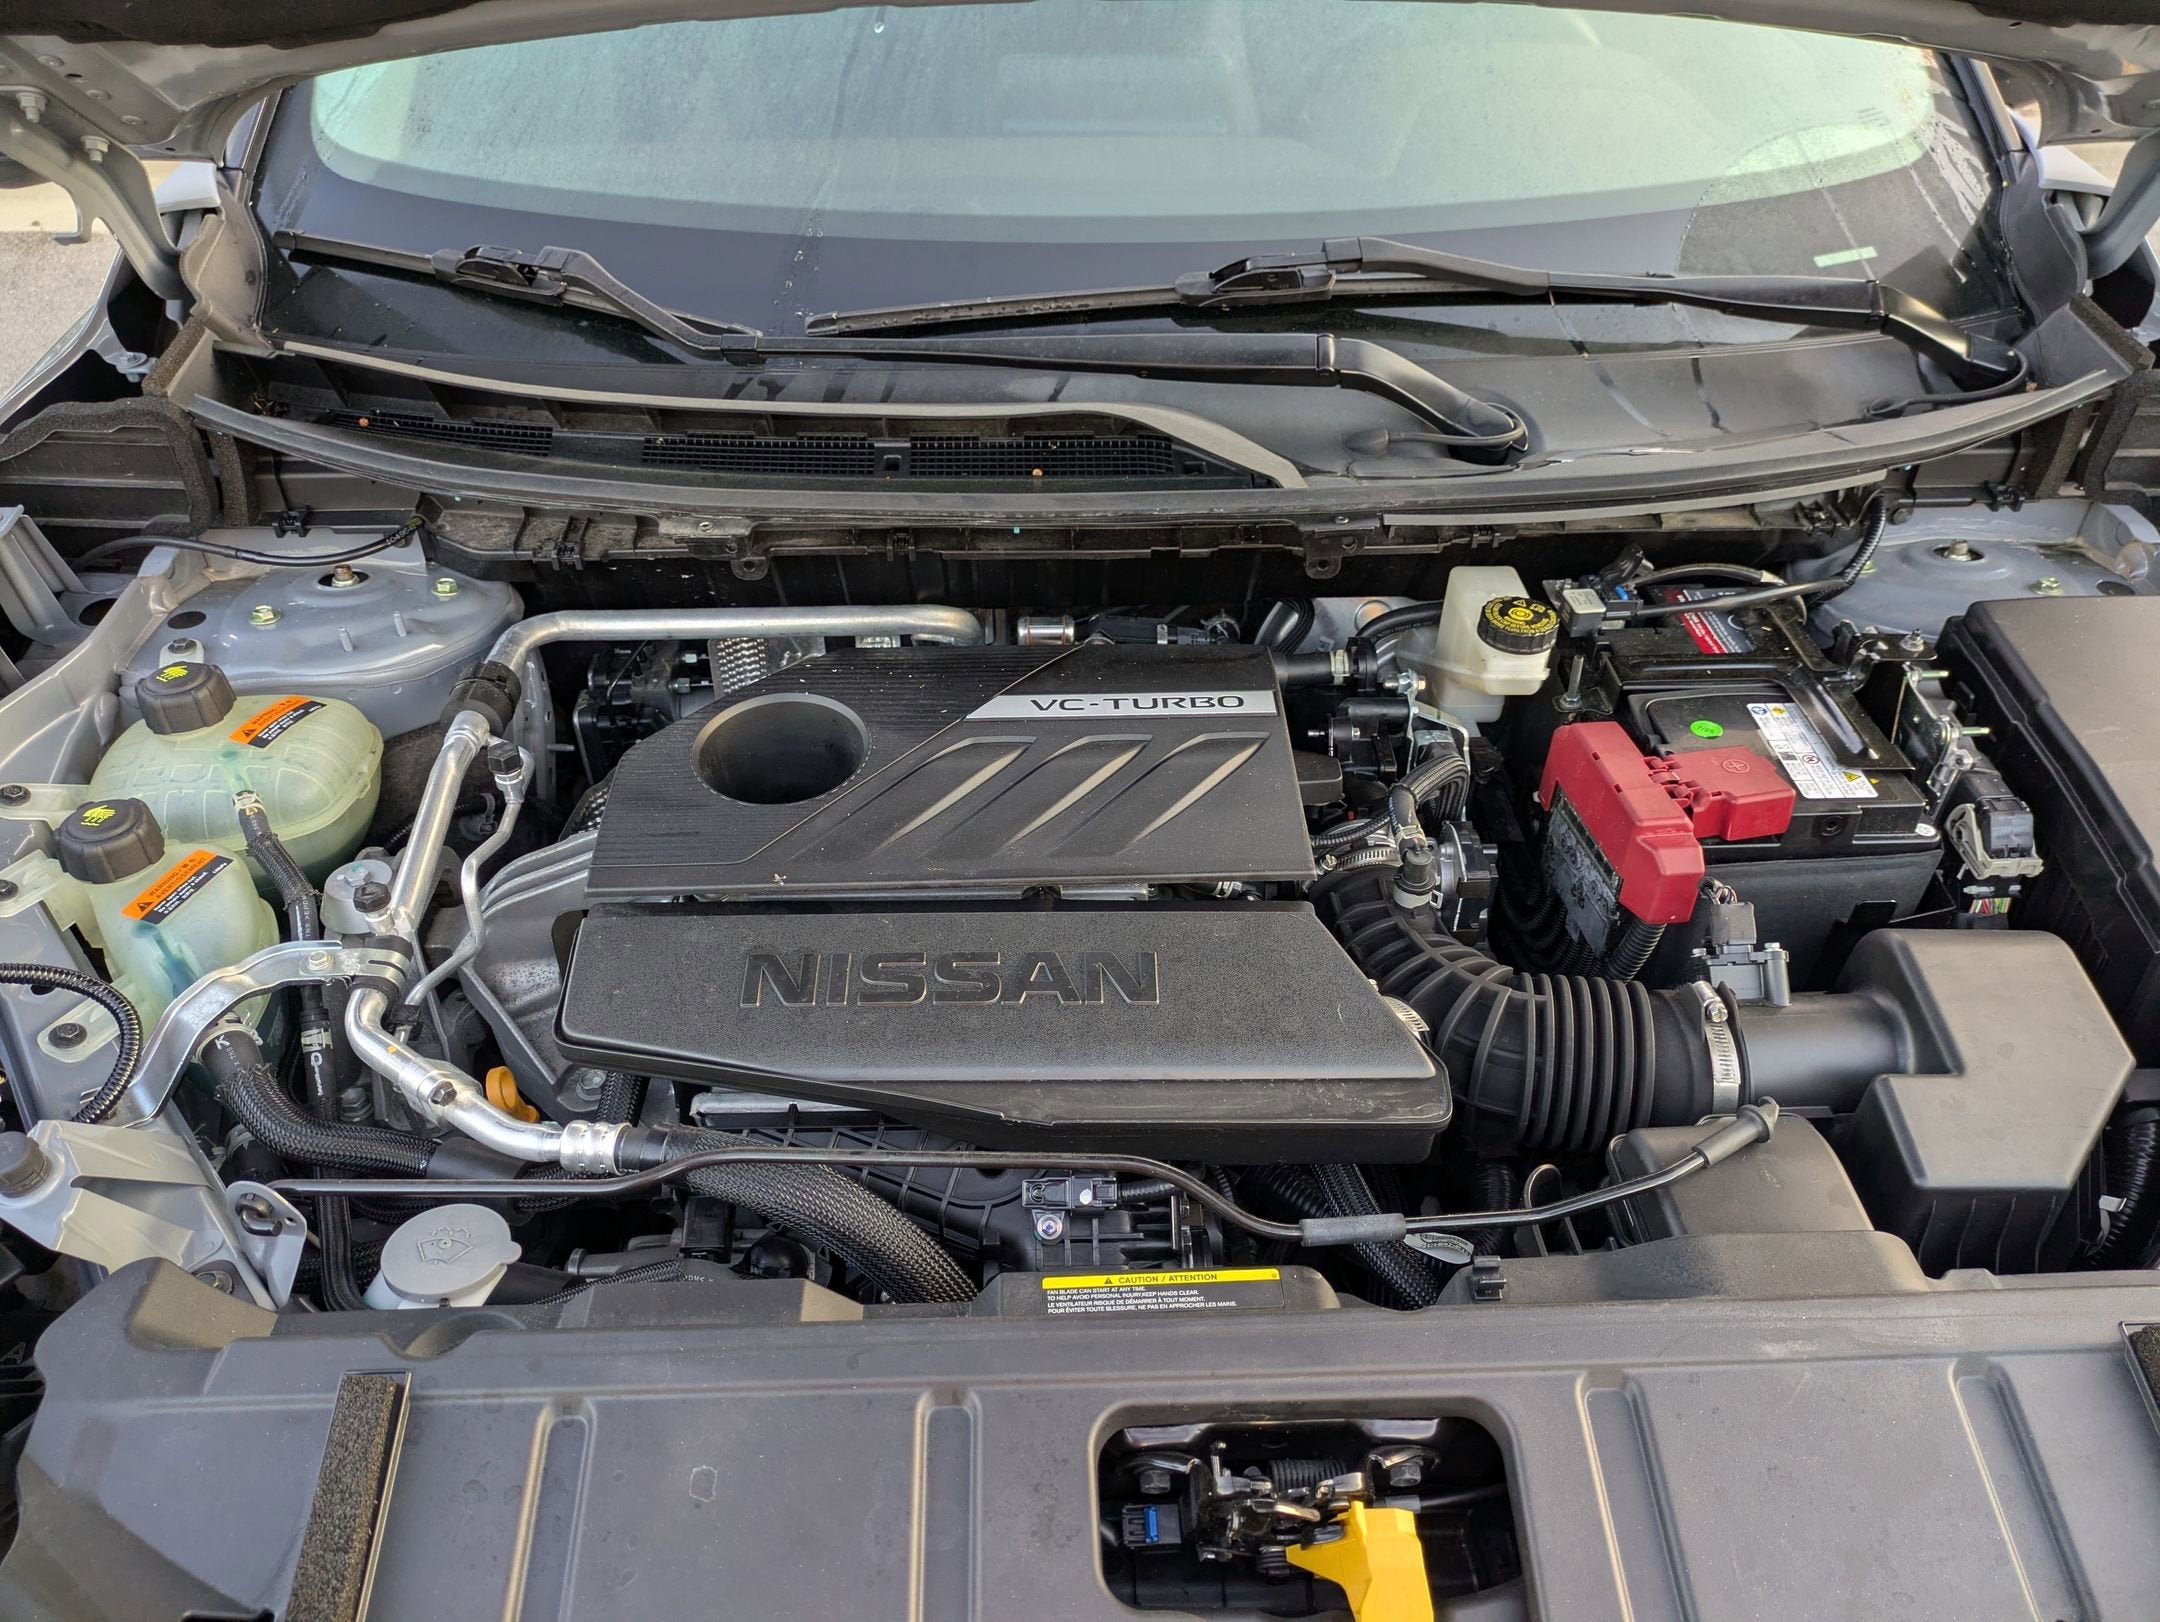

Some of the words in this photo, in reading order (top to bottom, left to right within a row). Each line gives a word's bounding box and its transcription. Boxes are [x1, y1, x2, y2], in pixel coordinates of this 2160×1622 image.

[1030, 695, 1245, 711] VC-TURBO
[740, 951, 1160, 1007] NISSAN
[1118, 1275, 1158, 1284] CAUTION
[1161, 1275, 1167, 1283] /
[1168, 1273, 1217, 1282] ATTENTION
